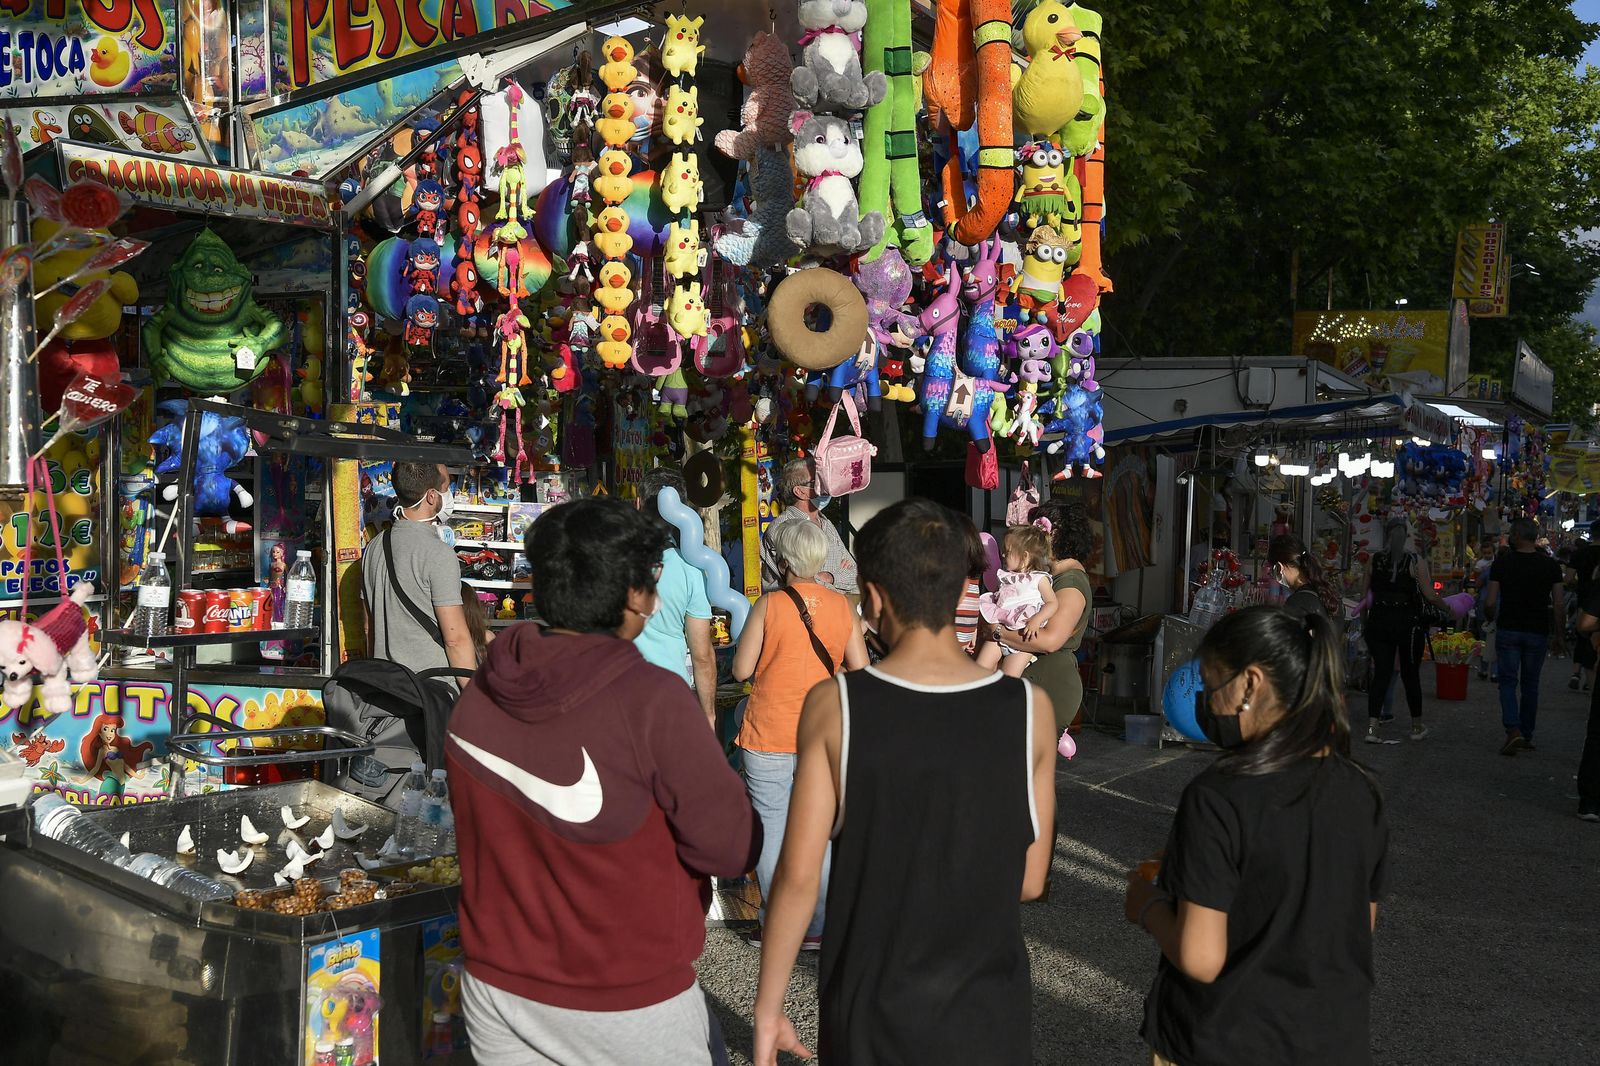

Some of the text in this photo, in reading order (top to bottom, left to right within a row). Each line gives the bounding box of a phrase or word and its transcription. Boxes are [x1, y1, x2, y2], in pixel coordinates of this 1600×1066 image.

[18, 31, 86, 83] TOCA
[68, 159, 328, 219] GRACIAS POR SU VISITA
[994, 319, 1018, 334] nergy
[84, 375, 102, 393] TE
[66, 390, 118, 413] QUIERO
[1, 558, 71, 577] PATOS
[0, 681, 241, 756] ATITOS
